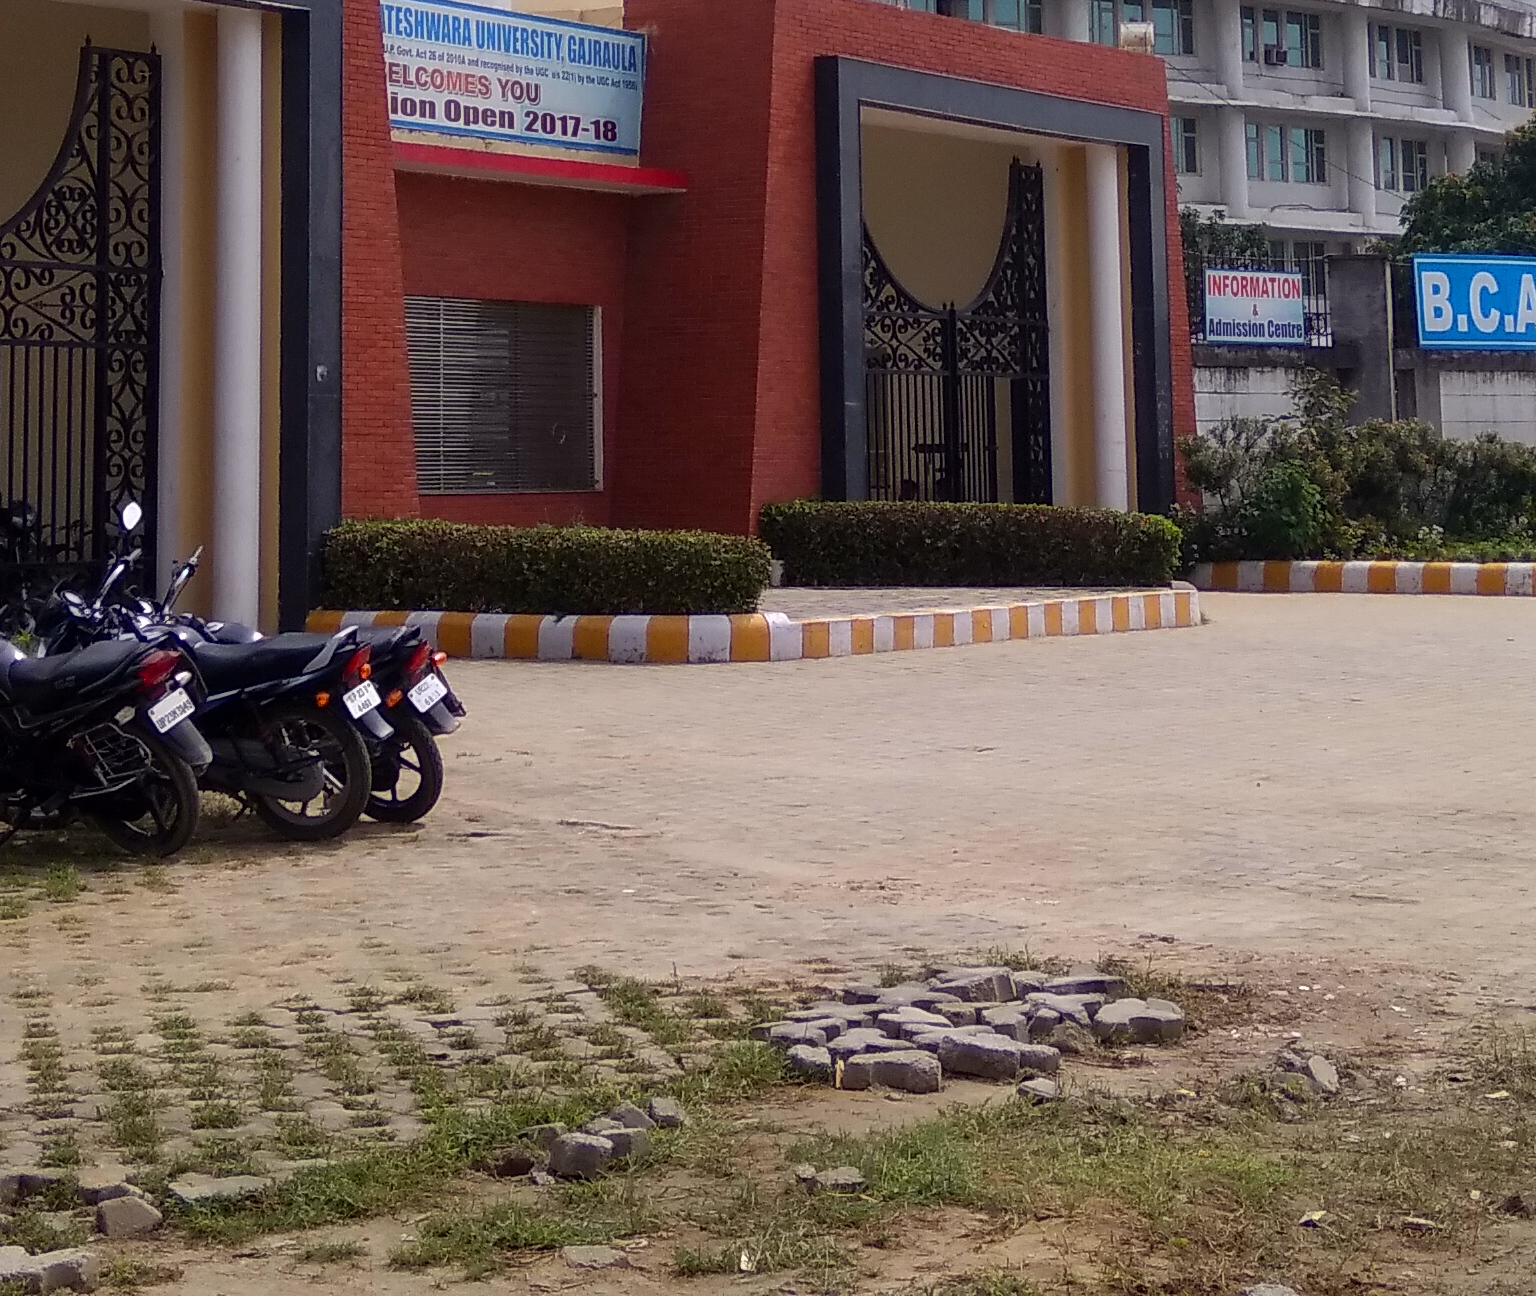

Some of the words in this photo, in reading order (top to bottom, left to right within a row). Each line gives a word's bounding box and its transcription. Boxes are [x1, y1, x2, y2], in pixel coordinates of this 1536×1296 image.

[475, 19, 564, 63] UNIVERSITY,
[567, 34, 637, 73] GAJRAULA
[396, 45, 414, 58] Govt.
[416, 48, 427, 60] Act
[438, 51, 445, 62] of
[467, 57, 479, 68] and
[480, 59, 514, 73] recognised
[515, 65, 523, 77] by
[524, 66, 534, 76] the
[535, 66, 549, 78] UGC
[577, 73, 585, 85] by
[585, 74, 596, 85] the
[596, 75, 610, 87] UGC
[611, 78, 621, 89] Act
[497, 78, 540, 104] YOU
[443, 98, 515, 130] Open
[524, 110, 618, 142] 2017-18
[1207, 274, 1301, 300] INFORMATION
[1252, 303, 1259, 317] &
[1208, 317, 1265, 338] Admission
[1267, 319, 1303, 339] Centre
